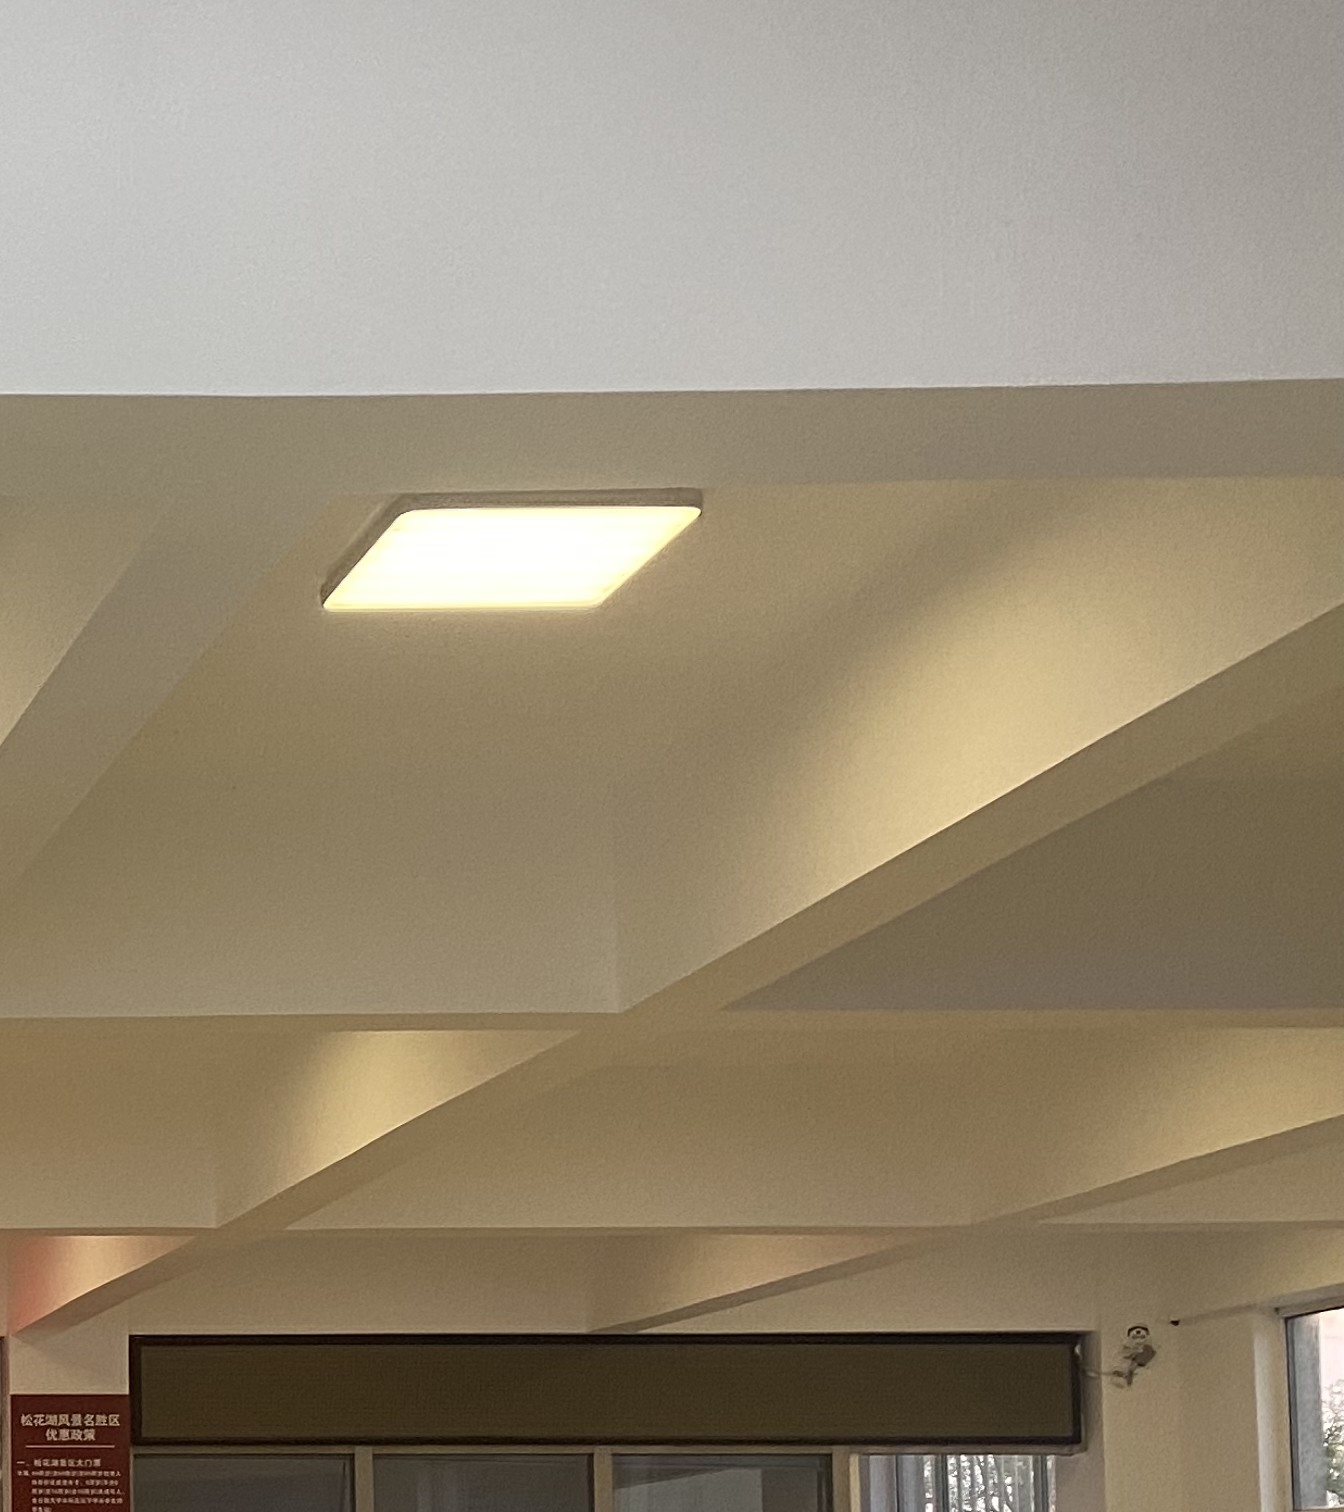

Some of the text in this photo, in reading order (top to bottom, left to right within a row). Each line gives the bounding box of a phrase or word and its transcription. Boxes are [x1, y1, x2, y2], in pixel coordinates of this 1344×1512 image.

[20, 1414, 121, 1427] 松花湖风景名胜区
[45, 1429, 96, 1441] 优惠政策
